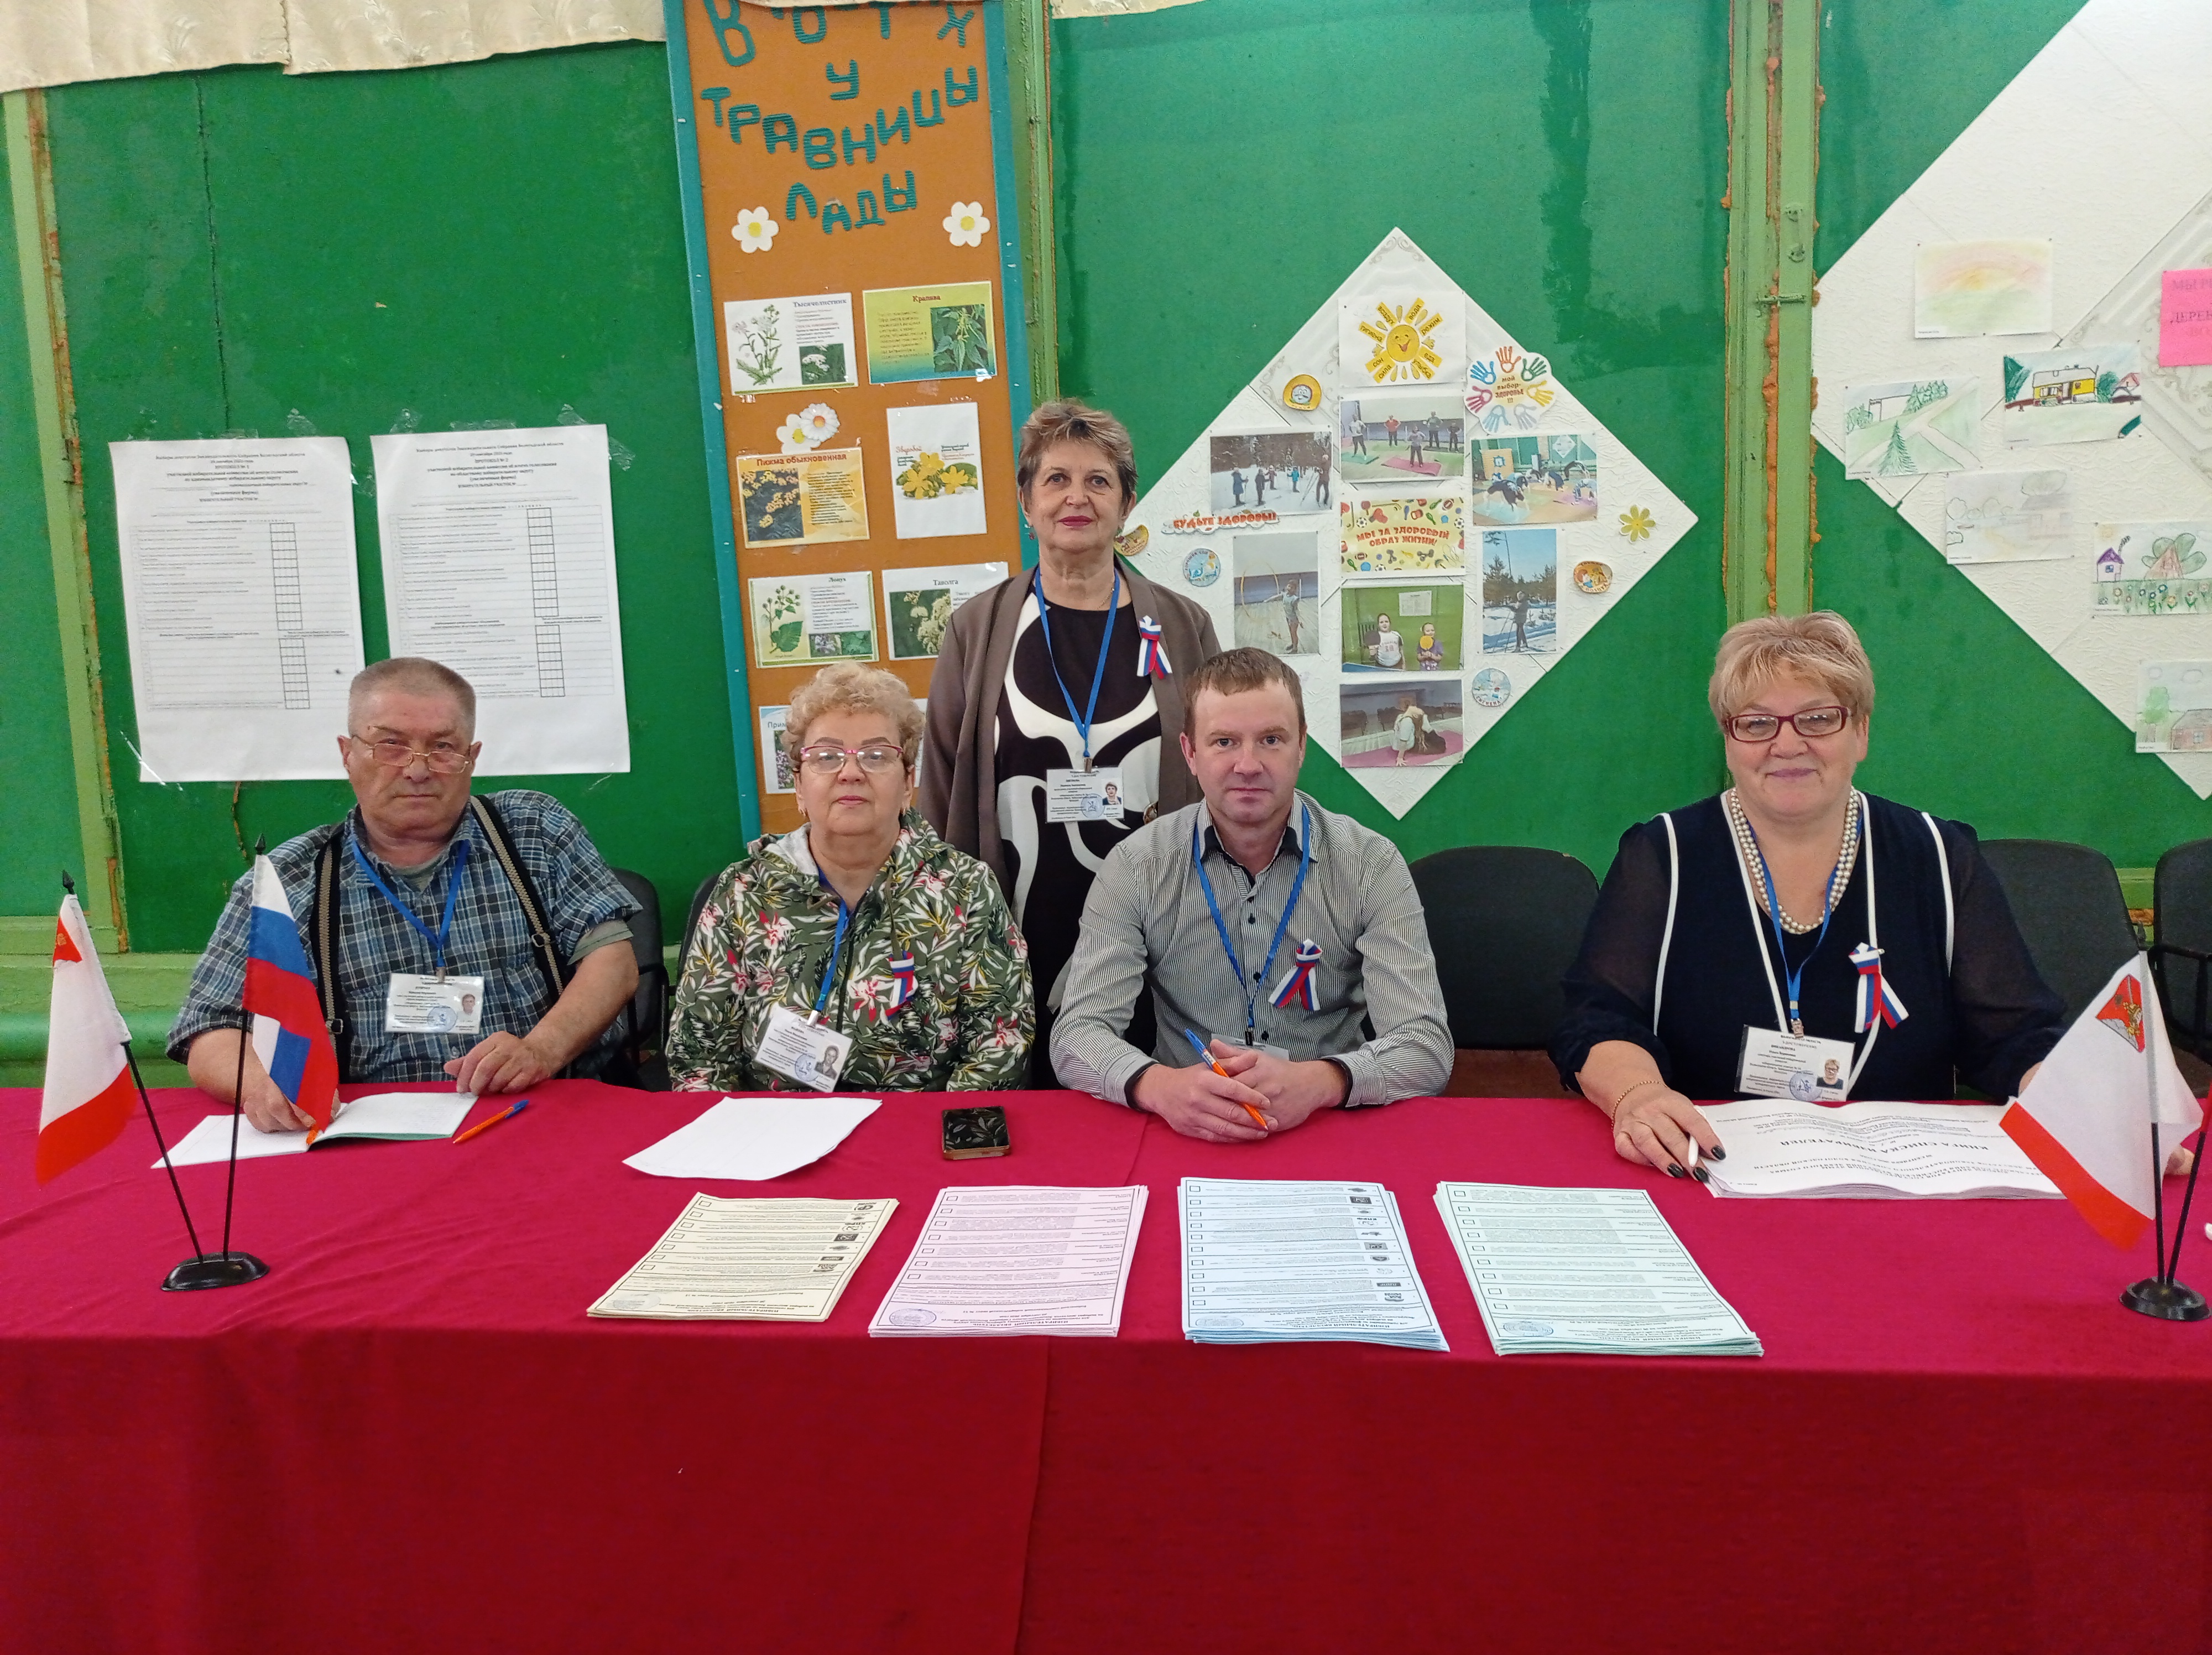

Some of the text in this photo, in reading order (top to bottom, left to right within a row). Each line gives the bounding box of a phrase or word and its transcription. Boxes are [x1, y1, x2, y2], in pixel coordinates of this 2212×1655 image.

[826, 59, 860, 101] У
[700, 65, 978, 170] ТРАВНИЦЫ
[785, 169, 918, 235] ЛАДЫ
[792, 298, 847, 309] Тысячелистник
[912, 294, 941, 303] Крапива
[1373, 357, 1384, 368] сон
[1378, 364, 1392, 379] сила
[757, 452, 847, 467] Пижма обыкновенная
[1173, 517, 1214, 529] БУДЬТЕ
[1357, 530, 1376, 542] МЫ
[1393, 526, 1450, 540] ЗДОРОВЫЙ
[1369, 536, 1400, 547] ОБРАЗ
[932, 578, 959, 586] Таволга
